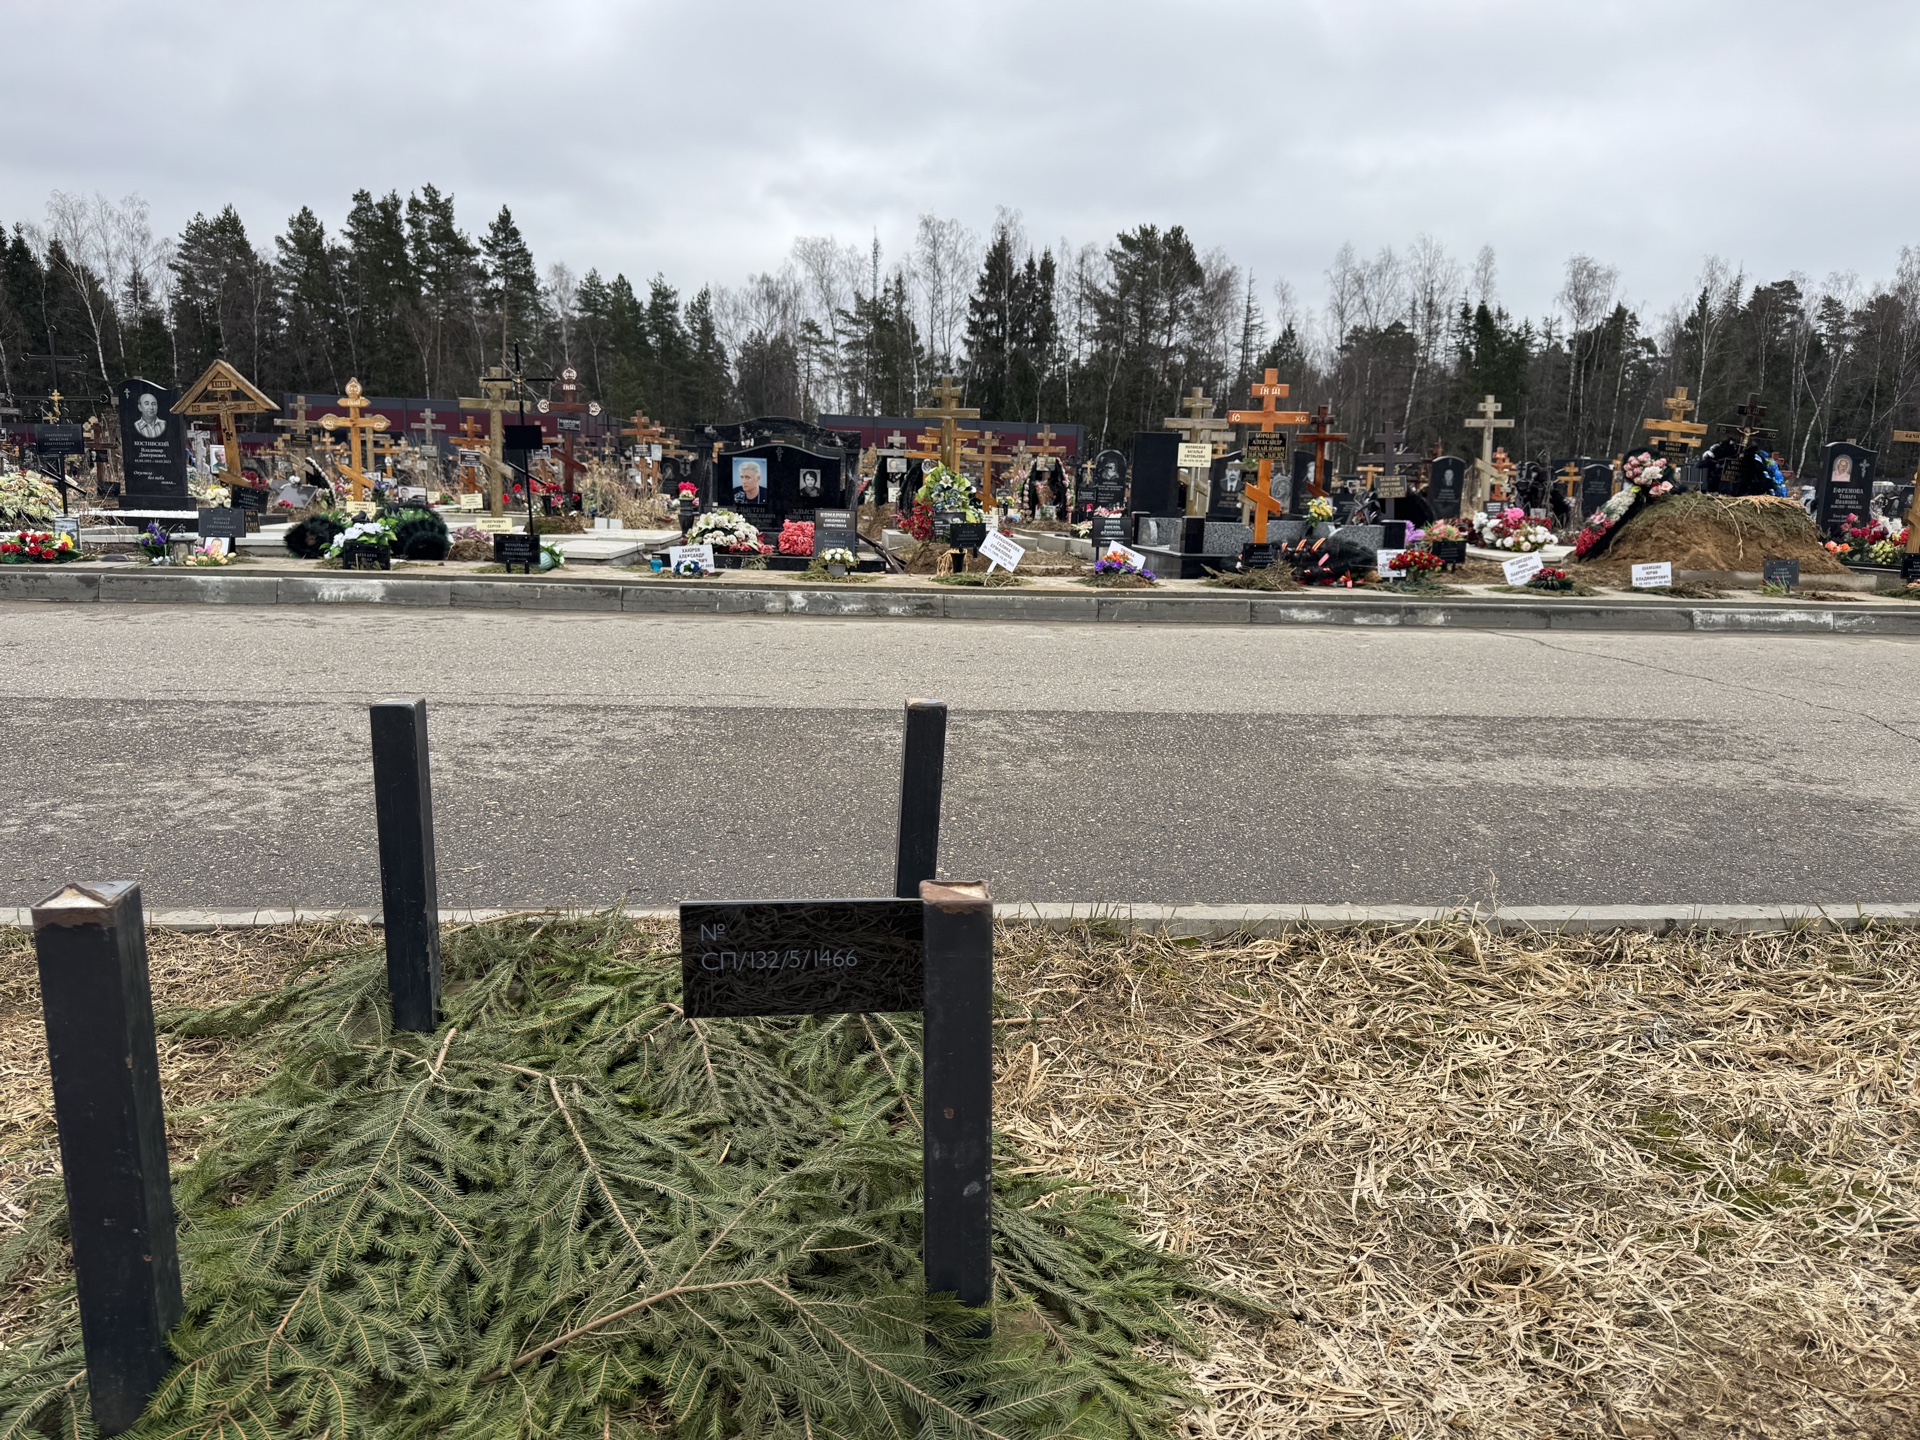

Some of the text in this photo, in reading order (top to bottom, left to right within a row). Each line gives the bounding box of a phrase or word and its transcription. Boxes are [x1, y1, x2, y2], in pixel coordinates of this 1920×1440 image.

[993, 533, 1020, 552] КАЛАШНИКОВА
[996, 542, 1011, 553] ГАЛИНА
[701, 924, 726, 942] №
[702, 949, 858, 970] СП/132/5/1466
